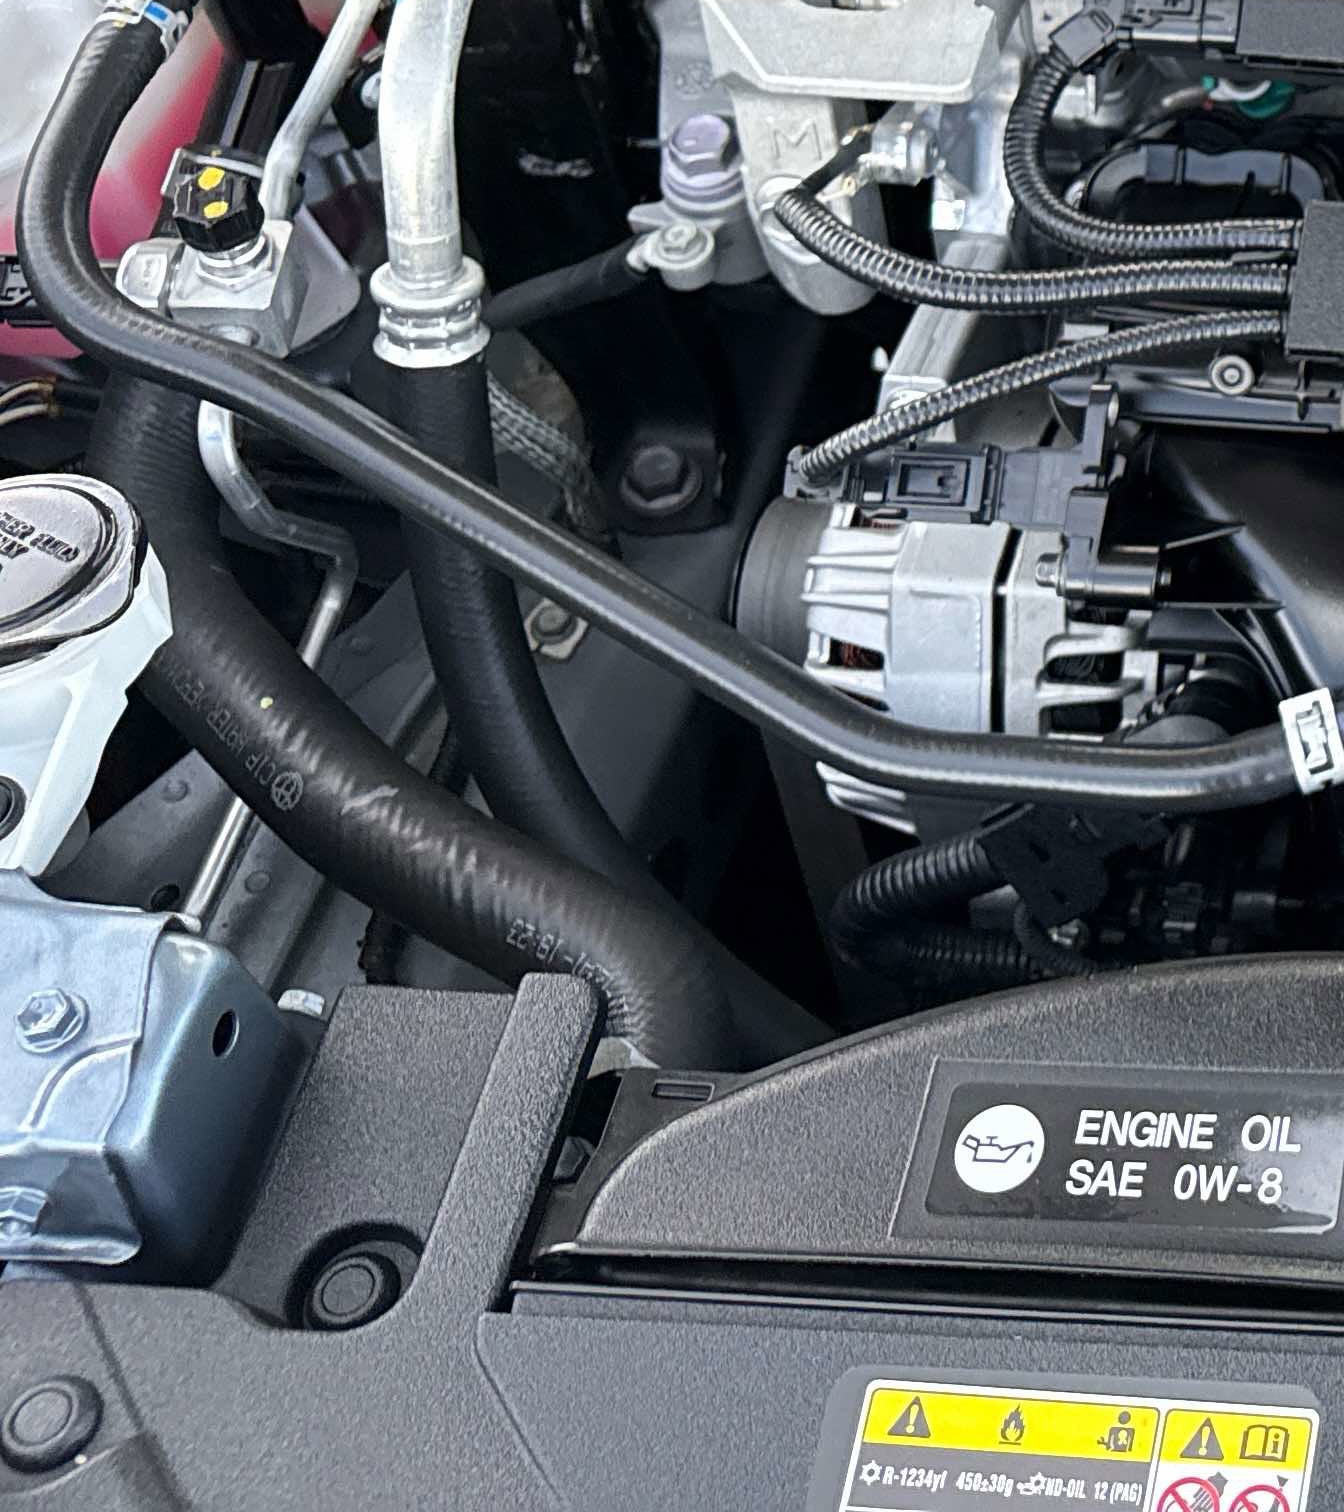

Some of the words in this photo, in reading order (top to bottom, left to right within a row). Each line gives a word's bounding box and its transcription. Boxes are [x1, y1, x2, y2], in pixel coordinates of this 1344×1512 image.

[772, 120, 822, 161] M
[1075, 1109, 1217, 1150] ENGINE
[1241, 1114, 1302, 1152] OIL
[1066, 1159, 1147, 1198] SAE
[1174, 1164, 1283, 1204] 0W-8
[882, 1466, 947, 1493] R-1234yf
[955, 1471, 1014, 1497] 450±30g
[1045, 1478, 1086, 1499] ND-OIL
[1094, 1481, 1108, 1500] 12
[1110, 1482, 1143, 1506] (PAG)
